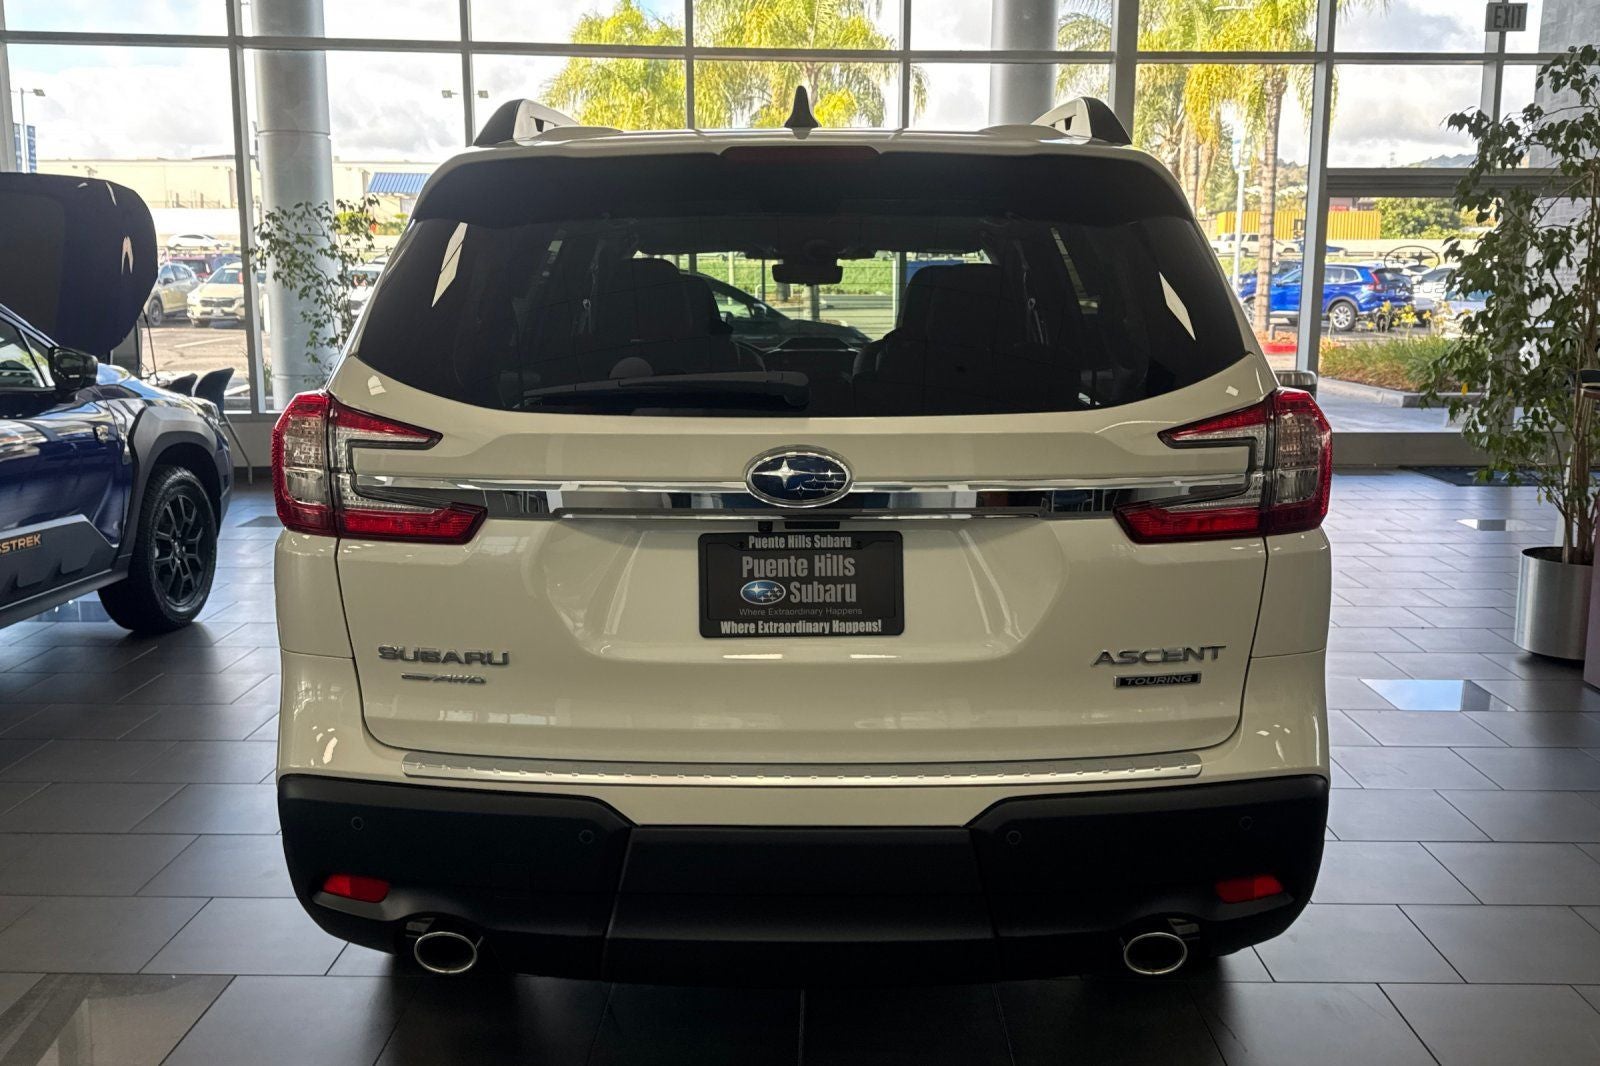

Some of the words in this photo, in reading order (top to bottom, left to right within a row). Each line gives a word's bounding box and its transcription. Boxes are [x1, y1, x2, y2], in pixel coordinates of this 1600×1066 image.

[1494, 5, 1524, 29] EXIT
[748, 535, 785, 549] Puente
[788, 534, 812, 549] Hills
[814, 534, 852, 548] Subaru
[741, 556, 808, 578] Puente
[814, 554, 856, 577] Hills
[789, 581, 857, 603] Subaru
[739, 608, 766, 616] Where
[768, 607, 823, 617] Extraordinary
[825, 606, 863, 616] Happens
[720, 620, 755, 634] Where
[757, 620, 830, 635] Extraordinary
[832, 619, 882, 634] Happens!
[378, 645, 509, 666] SUBARU
[1091, 645, 1227, 667] ASCENT
[1125, 674, 1193, 686] TOURING
